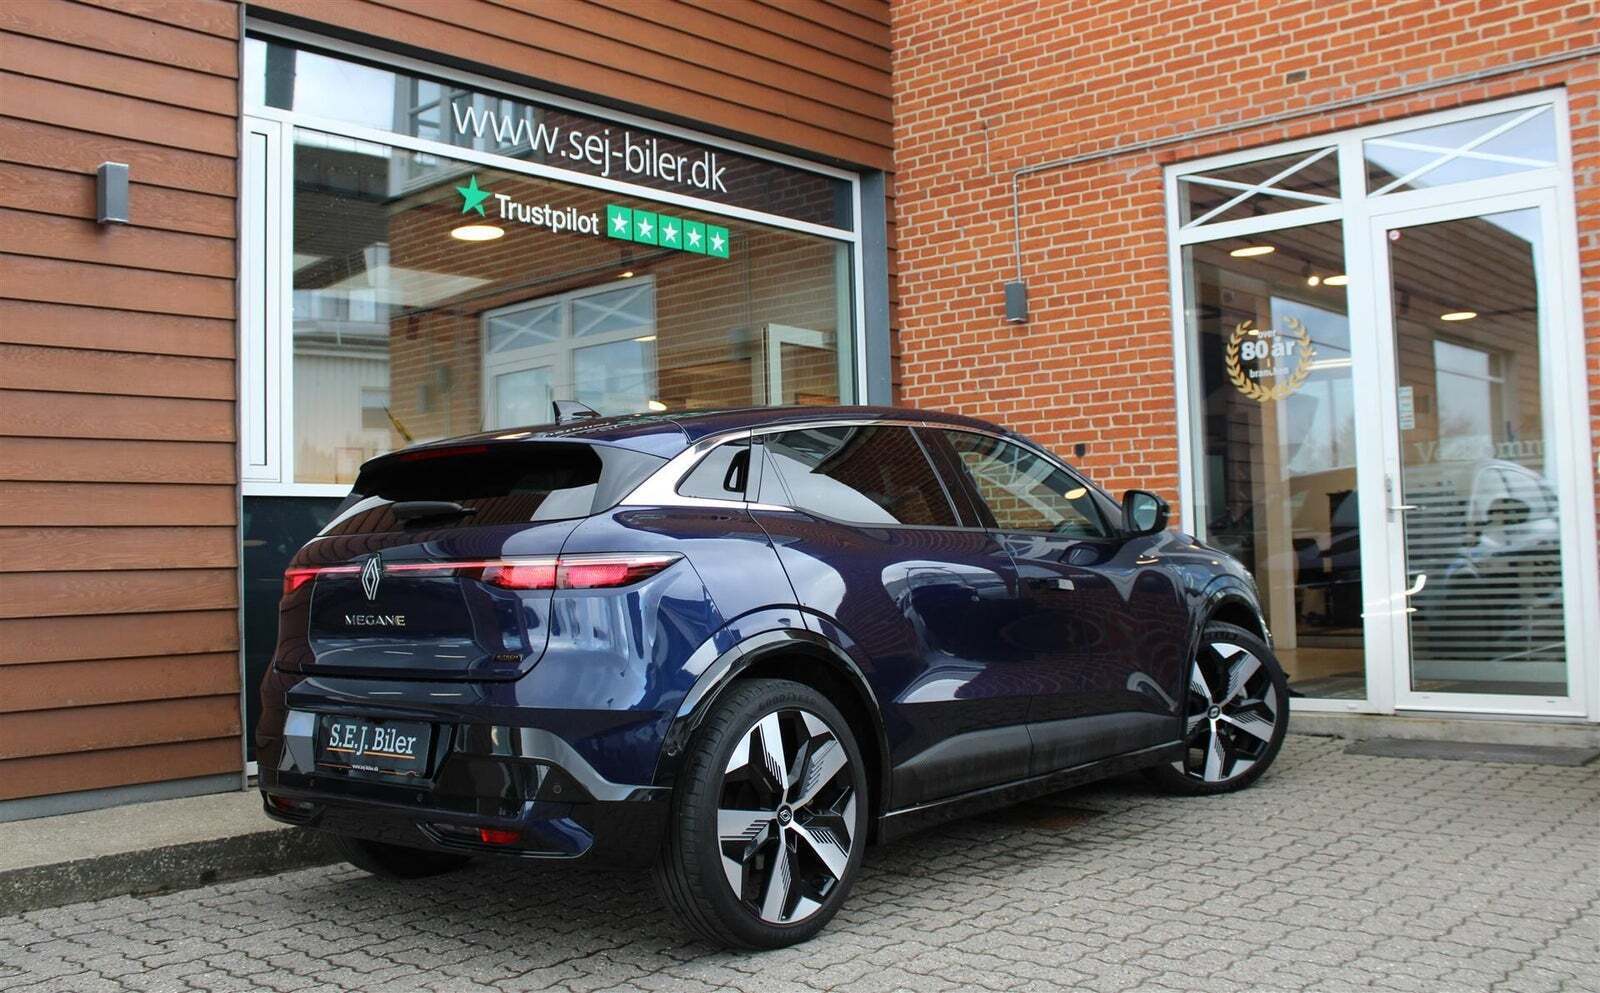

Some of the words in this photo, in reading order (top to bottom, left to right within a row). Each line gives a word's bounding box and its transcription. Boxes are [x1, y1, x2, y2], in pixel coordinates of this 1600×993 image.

[451, 101, 728, 193] www.sej-biler.dk
[494, 193, 600, 236] Trustpilot
[1241, 339, 1268, 361] 80
[1272, 336, 1295, 357] år
[345, 614, 406, 627] MEGANE
[329, 723, 368, 755] S.E.J.
[372, 727, 417, 754] Biler
